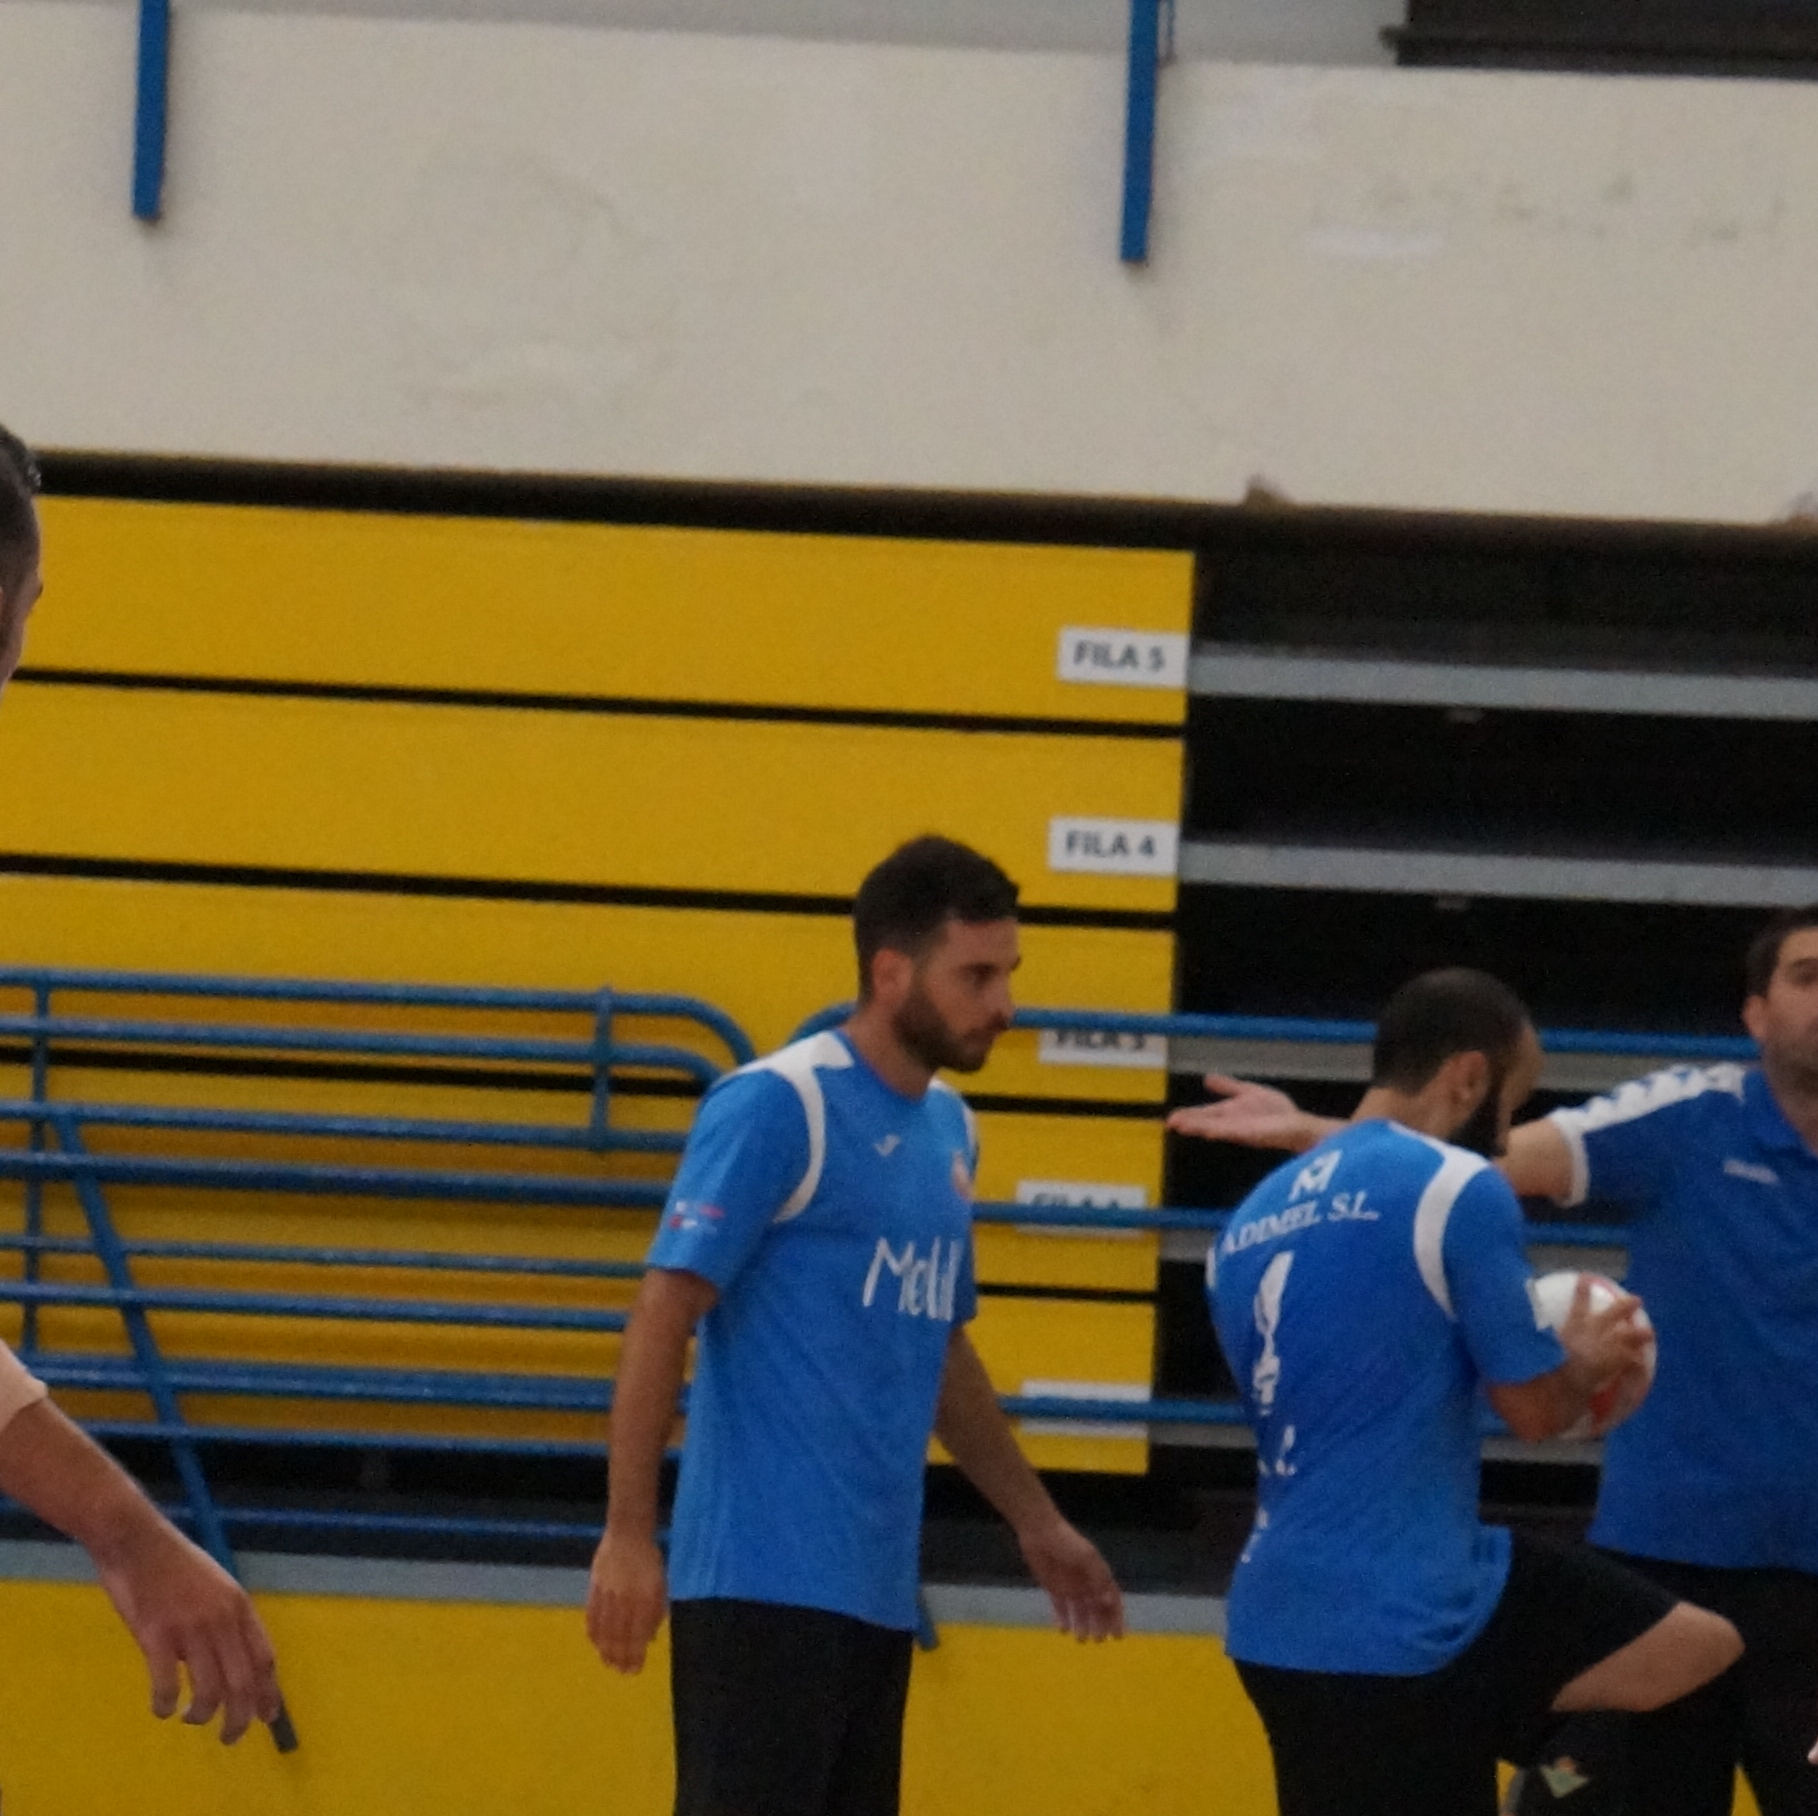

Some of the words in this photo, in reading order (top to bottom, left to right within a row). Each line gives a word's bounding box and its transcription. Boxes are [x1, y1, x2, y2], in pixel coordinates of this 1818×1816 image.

[1072, 638, 1140, 670] FILA
[1065, 829, 1130, 858] FILA
[1138, 834, 1156, 858] 4
